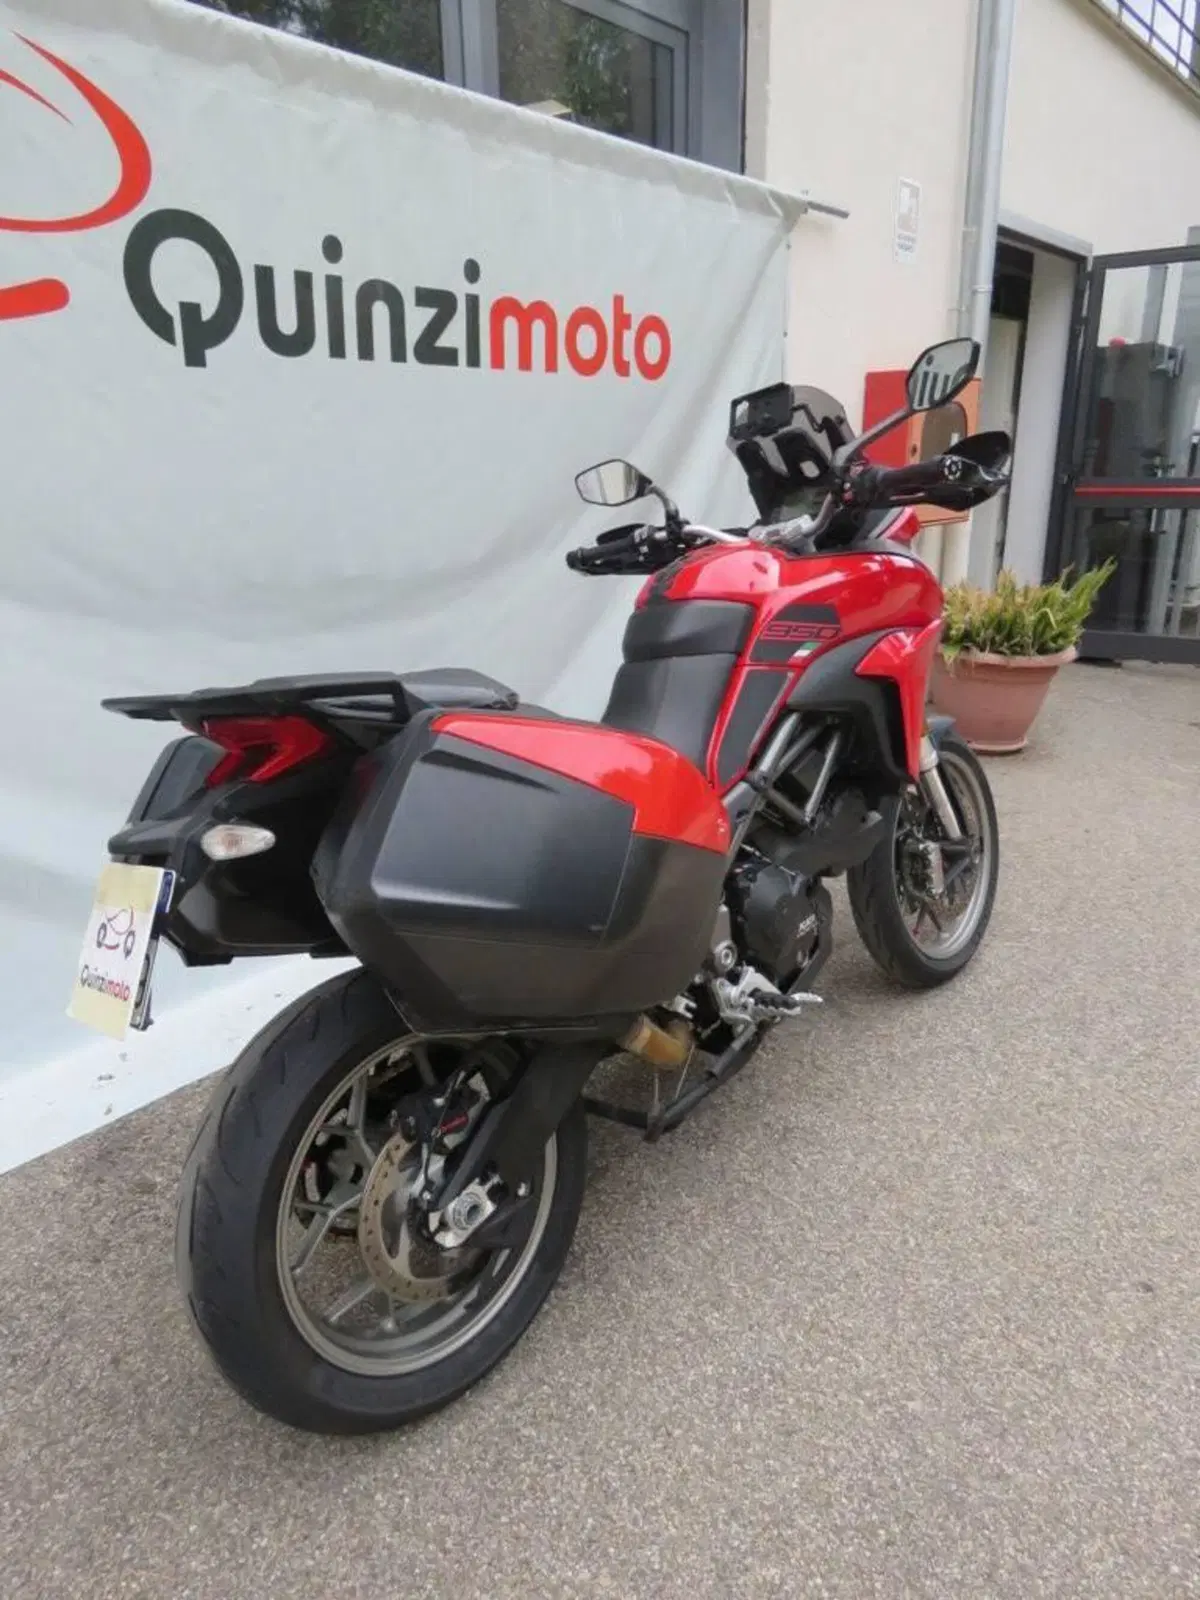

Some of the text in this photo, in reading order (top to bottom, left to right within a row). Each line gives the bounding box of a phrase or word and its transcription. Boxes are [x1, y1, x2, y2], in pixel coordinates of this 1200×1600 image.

[123, 208, 671, 380] Quinzimoto
[760, 620, 840, 642] 950
[80, 964, 131, 1002] Quinzimoto
